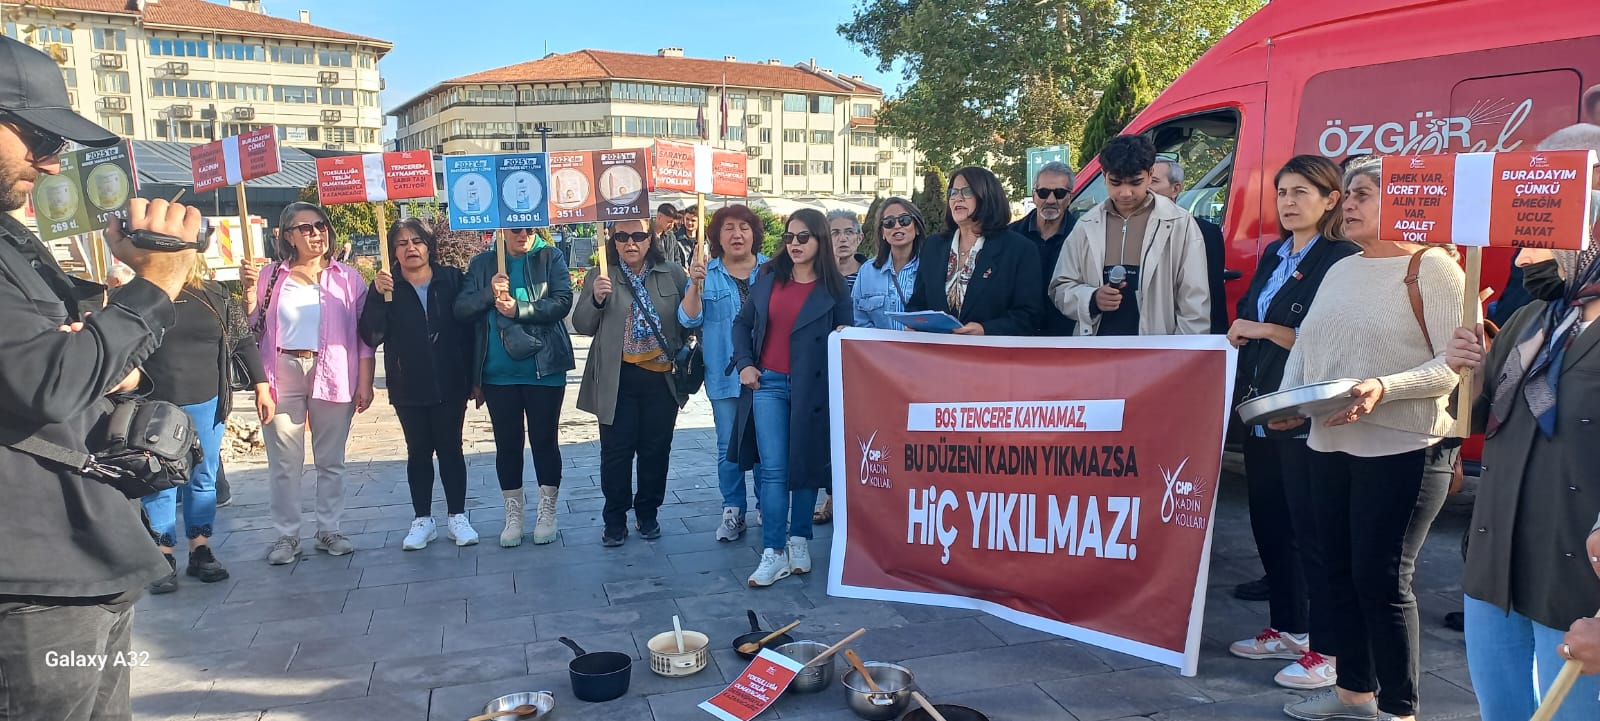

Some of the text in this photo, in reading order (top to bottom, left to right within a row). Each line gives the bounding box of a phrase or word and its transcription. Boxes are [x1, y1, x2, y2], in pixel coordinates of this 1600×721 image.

[241, 133, 271, 145] BURADAYIM
[248, 141, 266, 151] ÇÜNKÜ
[322, 168, 359, 177] YOKSULLUĞA
[391, 163, 425, 171] TENCEREM
[659, 168, 692, 177] SOFRADA
[1391, 173, 1417, 182] EMEK
[1502, 169, 1577, 180] BURADAYIM
[196, 178, 211, 188] HAKKI
[1387, 183, 1447, 197] ÜCRET YOK;
[1515, 182, 1560, 196] ÇÜNKÜ
[1392, 197, 1415, 206] ALIN
[1512, 196, 1562, 208] EMEĞİM
[557, 210, 574, 218] 351
[606, 206, 630, 214] 1.227
[459, 215, 481, 224] 16.95
[507, 214, 531, 222] 49.90
[51, 222, 68, 233] 269
[1394, 220, 1435, 230] ADALET
[1403, 231, 1427, 241] YOK!
[1514, 226, 1555, 236] HAYAT
[935, 405, 1087, 432] BOŞ TENCERE KAYNAMAZ,
[869, 449, 880, 462] CHP
[905, 436, 1138, 477] BU DÜZENİ KADIN YIKMAZSA
[870, 464, 887, 475] KADIN
[870, 476, 893, 489] KOLLARI
[1176, 481, 1192, 495] CHP
[1175, 497, 1201, 512] KADIN
[967, 491, 1140, 561] YIKILMAZ!
[1175, 513, 1206, 529] KOLLARI
